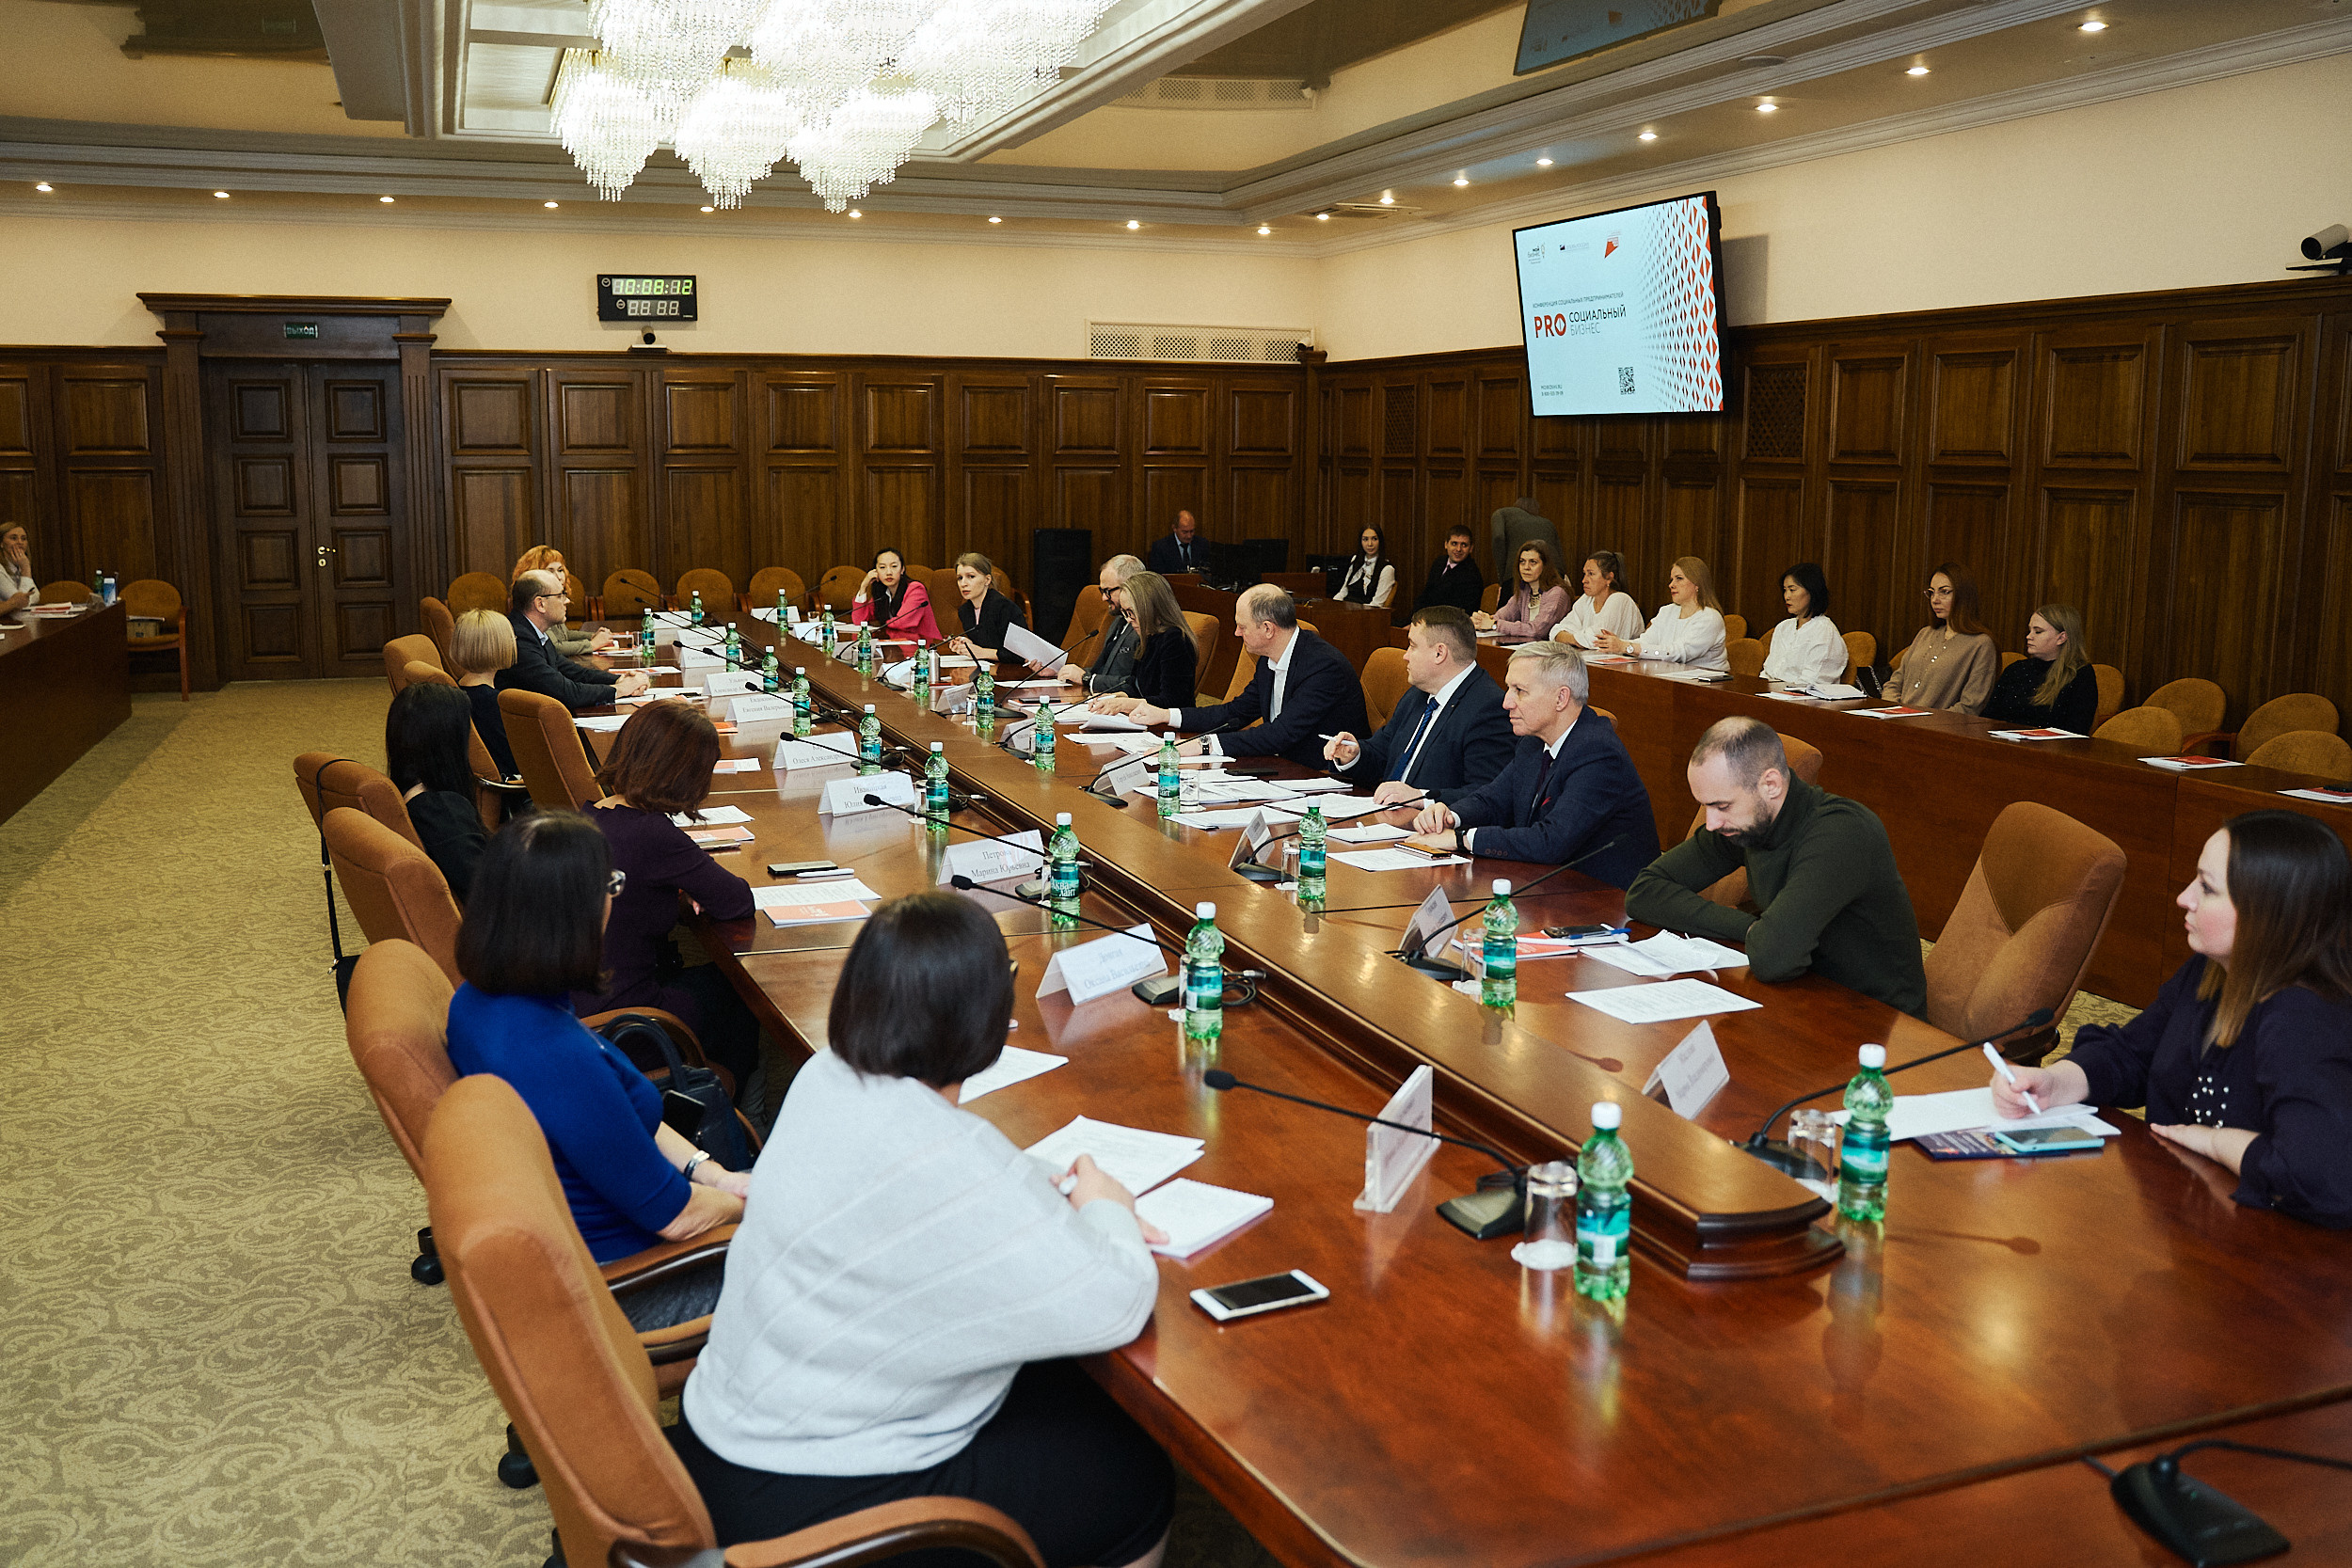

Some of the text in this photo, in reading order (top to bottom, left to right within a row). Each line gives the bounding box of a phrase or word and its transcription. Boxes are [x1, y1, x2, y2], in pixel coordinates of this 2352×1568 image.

[1568, 304, 1627, 323] СОЦИАЛЬНЫЙ
[1534, 313, 1567, 339] PRO
[1570, 322, 1601, 337] БИЗНЕС
[971, 862, 1031, 879] Марина Юрьевна
